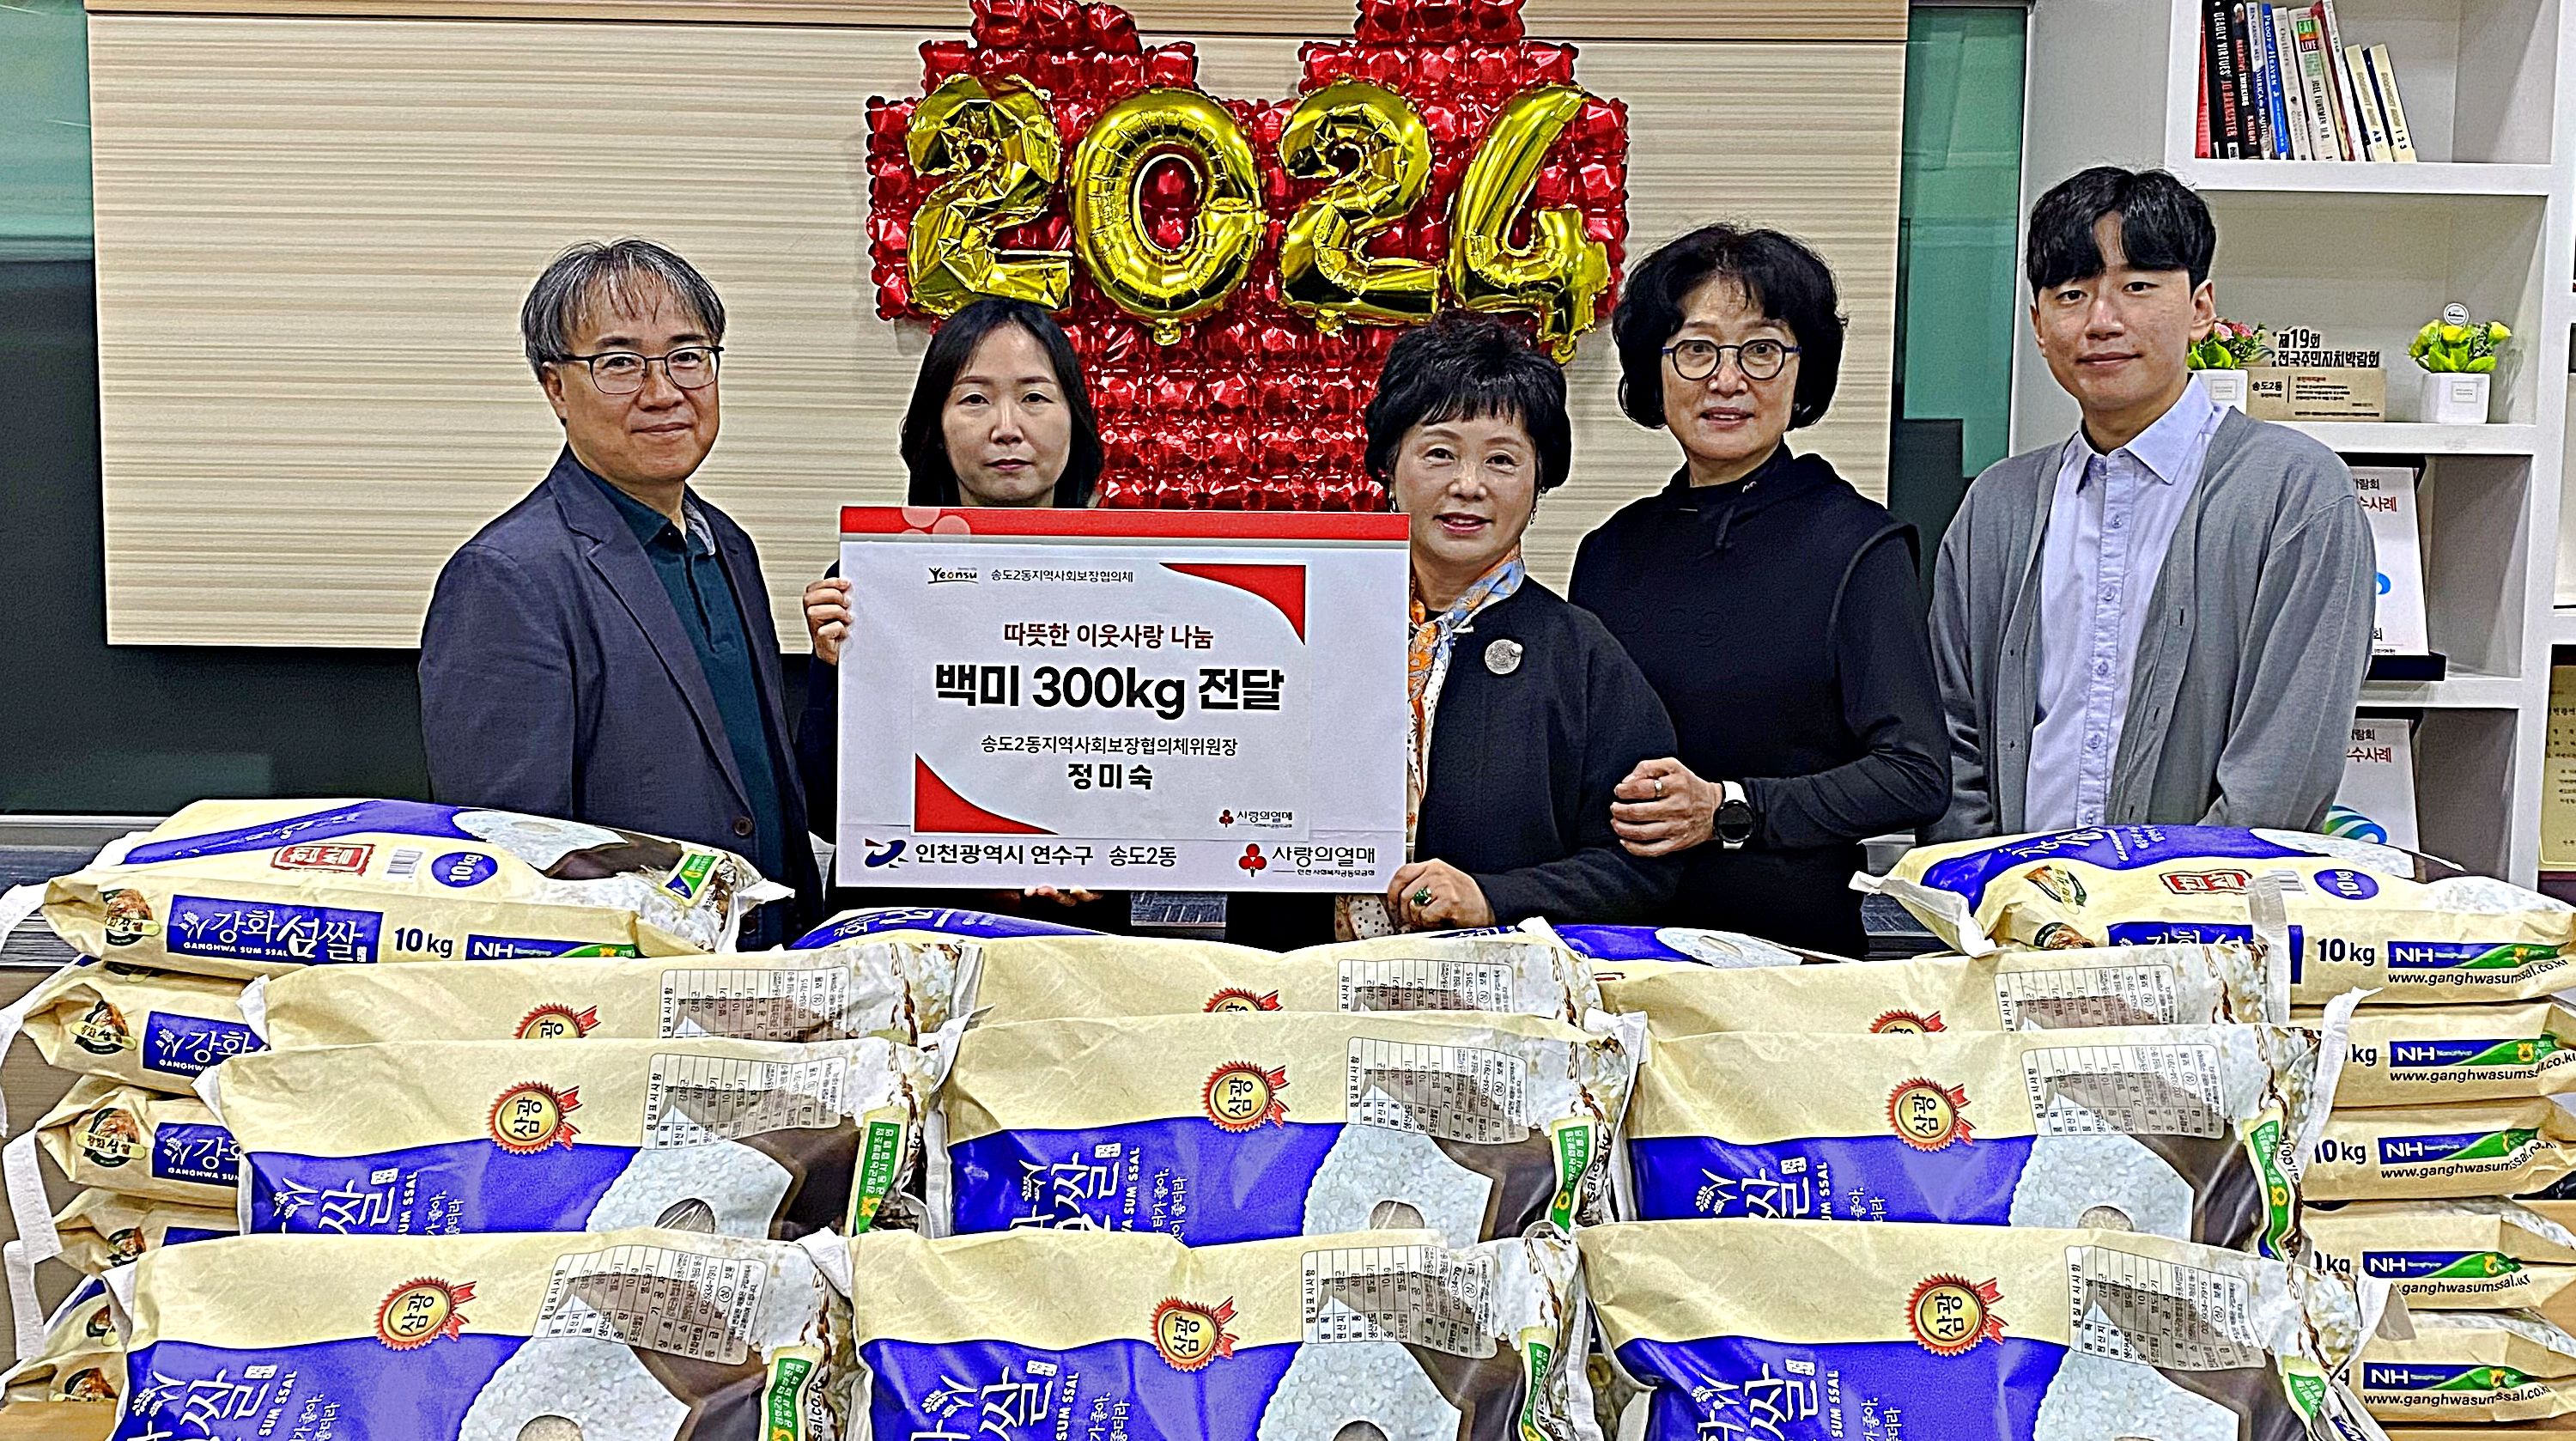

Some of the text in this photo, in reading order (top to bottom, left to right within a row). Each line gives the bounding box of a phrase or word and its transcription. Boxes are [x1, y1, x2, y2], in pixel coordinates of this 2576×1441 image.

[2214, 12, 2227, 40] DEADLY
[2217, 43, 2231, 75] VIRTUES
[2239, 73, 2249, 106] THINKING
[2247, 115, 2257, 145] KNIGHT
[906, 73, 1611, 359] 2024
[2278, 350, 2380, 368] 전국주민자치박람회
[2252, 381, 2282, 392] 송도2동
[928, 567, 978, 584] Yeonsu
[991, 568, 1133, 583] 송도2동지역사회보장협의체
[1004, 622, 1214, 650] 따뜻한 이웃사랑 나눔
[935, 664, 1285, 720] 백미 300kg 전달
[981, 735, 1238, 757] 송도2동지역사회보장협의체위원장
[1067, 763, 1153, 790] 정미숙
[1236, 811, 1293, 824] 사랑의열매
[448, 854, 483, 881] 10kg
[914, 843, 1177, 867] 인천광역시 연수구 송도2동
[1272, 846, 1376, 867] 사랑의열매
[2335, 870, 2363, 897] 10kg
[183, 941, 289, 958] GANGHWA SUM SSAL
[210, 909, 363, 963] 강화섬쌀
[473, 940, 514, 959] NH
[2395, 947, 2433, 963] NH
[662, 988, 672, 1038] 질표시사항
[540, 1020, 564, 1038] 광
[2397, 1047, 2435, 1061] NH
[1227, 1079, 1256, 1115] 삼광
[512, 1097, 544, 1135] 삼광
[1913, 1095, 1939, 1136] 삼광
[1127, 1147, 1140, 1181] SSAL
[2385, 1143, 2424, 1157] NH
[168, 1167, 218, 1179] GANGHWA
[398, 1171, 417, 1233] UM SSAL
[1124, 1187, 1138, 1214] SUM
[1170, 1177, 1188, 1215] 좋더라
[1816, 1162, 1832, 1220] UM SSAL
[1868, 1197, 1887, 1221] 더라
[2370, 1257, 2406, 1272] NH
[400, 1294, 435, 1334] 삼광
[1936, 1295, 1964, 1336] 삼광
[1173, 1317, 1200, 1355] 삼광
[2371, 1369, 2409, 1383] NH
[258, 1371, 297, 1436] SUM SSAL
[808, 1377, 827, 1441] sal.co.kr
[1056, 1372, 1079, 1441] SUM SSAL
[1826, 1370, 1843, 1438] SUM SSAL
